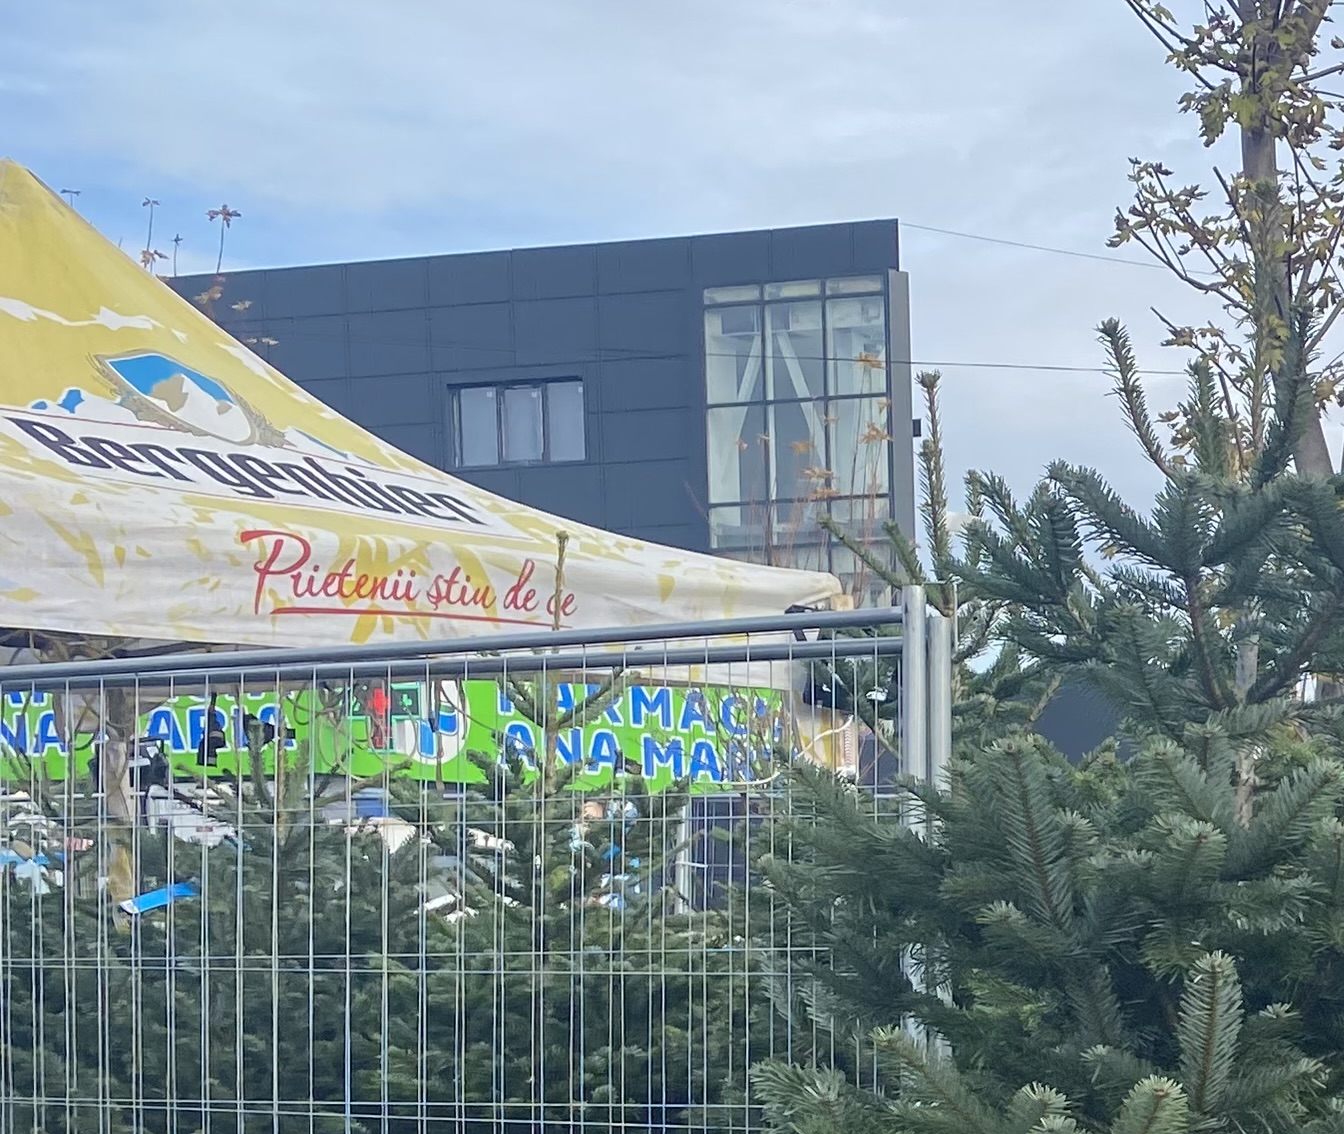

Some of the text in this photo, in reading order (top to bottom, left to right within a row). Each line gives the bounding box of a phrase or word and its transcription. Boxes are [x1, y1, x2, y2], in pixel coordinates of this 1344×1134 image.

[4, 416, 488, 525] Bergenbier
[240, 530, 420, 615] Prietenii
[503, 558, 540, 611] de
